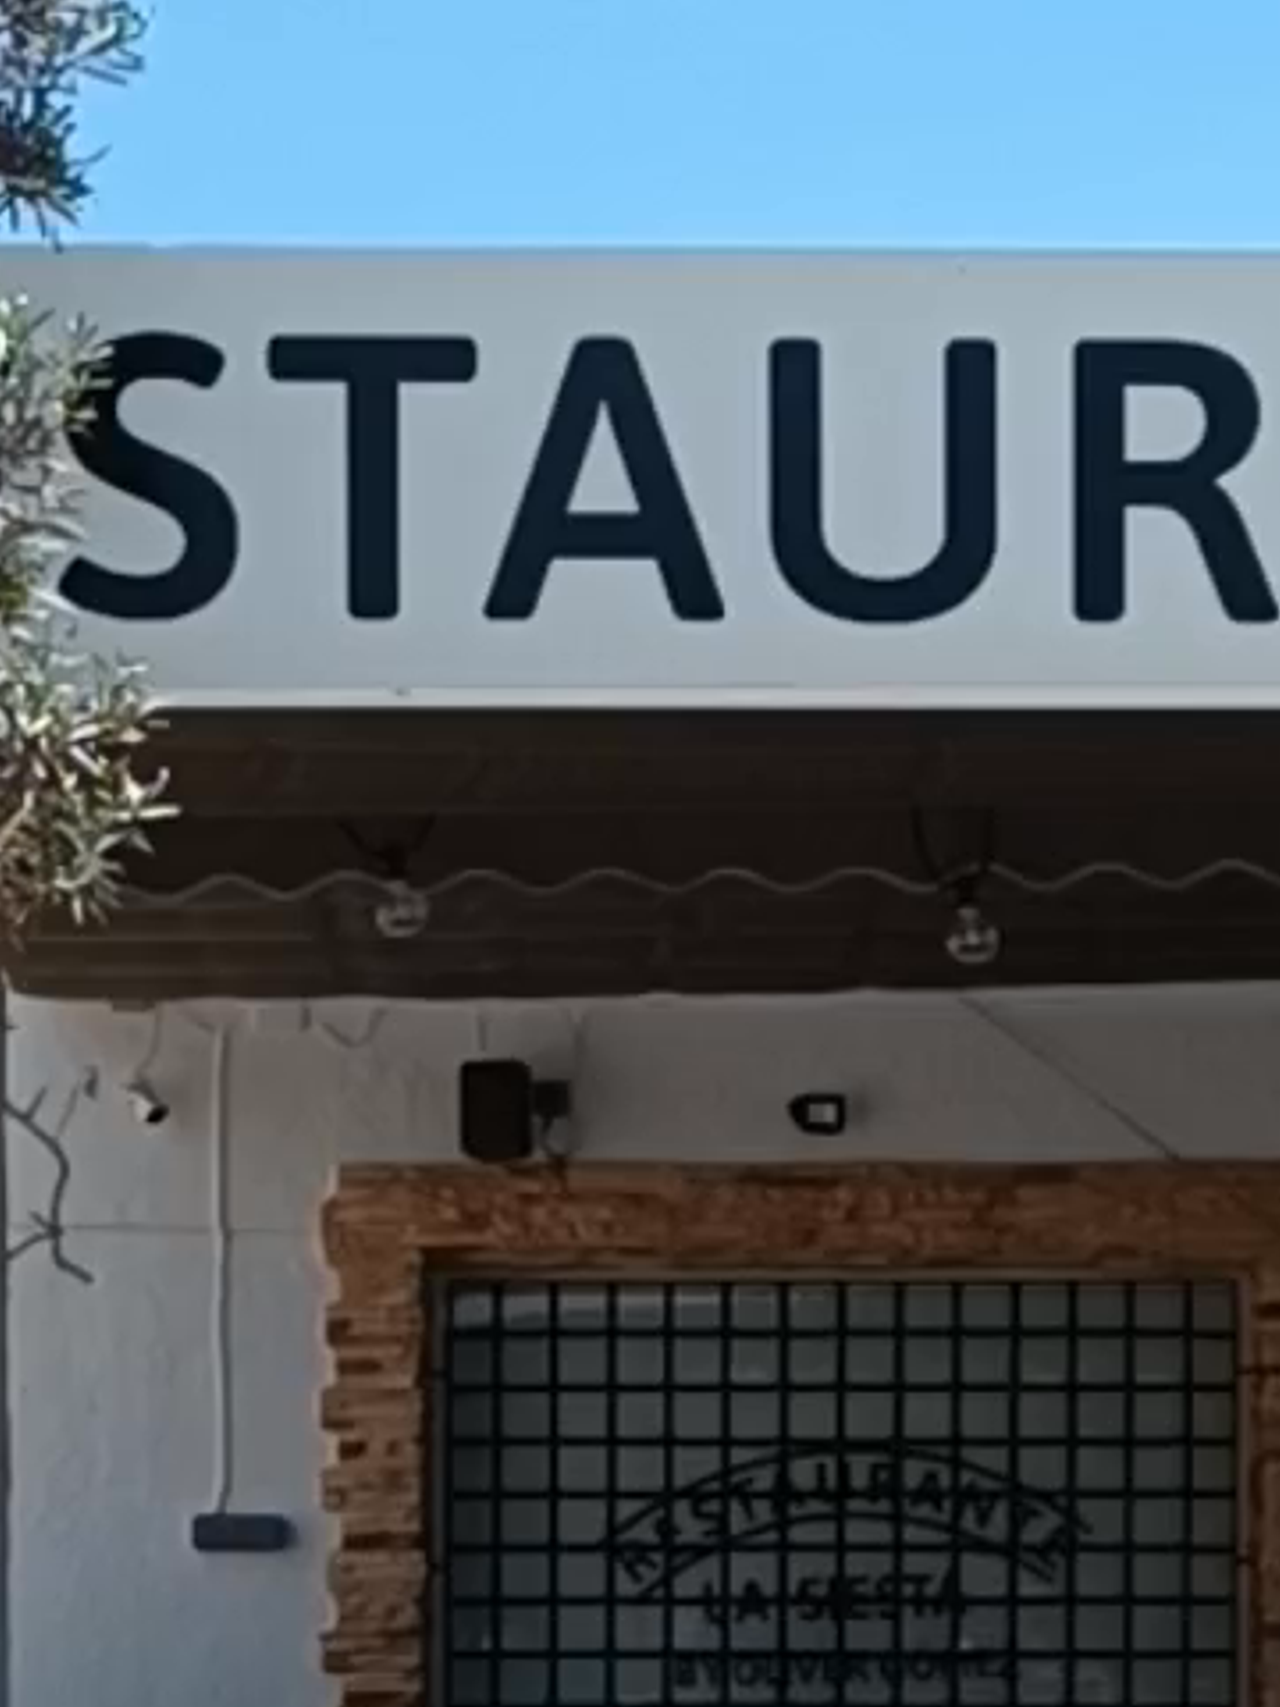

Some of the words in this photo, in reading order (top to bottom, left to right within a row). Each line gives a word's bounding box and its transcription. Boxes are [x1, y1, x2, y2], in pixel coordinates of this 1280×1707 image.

[614, 1459, 1074, 1584] RESTAURANTE
[703, 1577, 770, 1625] LA
[796, 1568, 967, 1623] SIESTA
